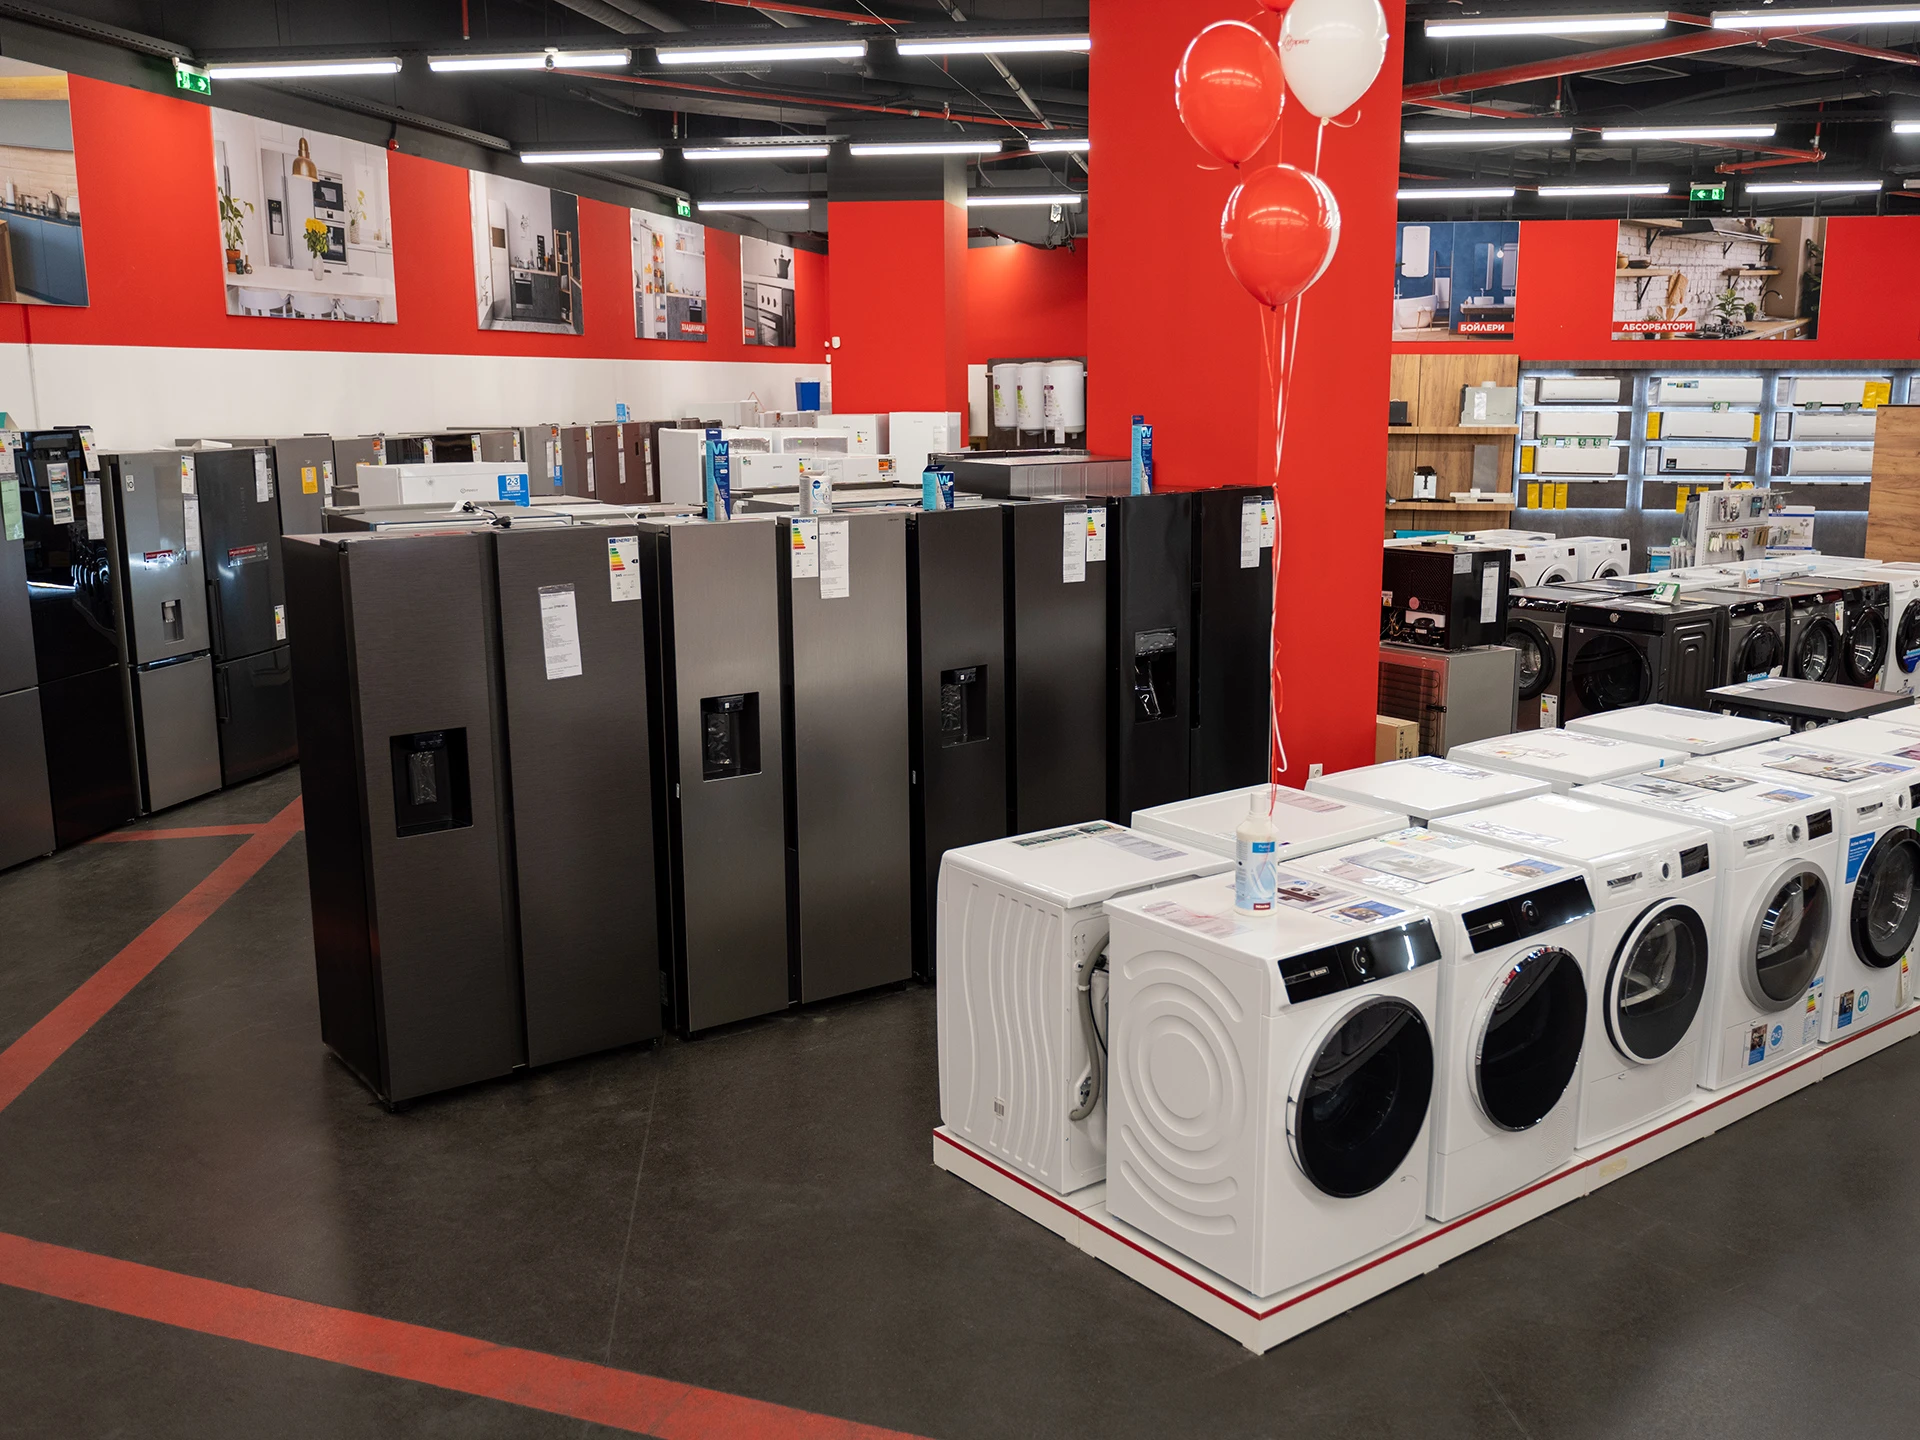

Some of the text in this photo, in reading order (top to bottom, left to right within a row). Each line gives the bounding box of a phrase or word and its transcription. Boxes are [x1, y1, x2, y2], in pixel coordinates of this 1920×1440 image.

[1460, 322, 1505, 332] БОЙЛЕРИ
[1622, 322, 1693, 331] АБСОРБАТОРИ
[1314, 968, 1327, 976] BOSCH
[1858, 995, 1868, 1009] 10
